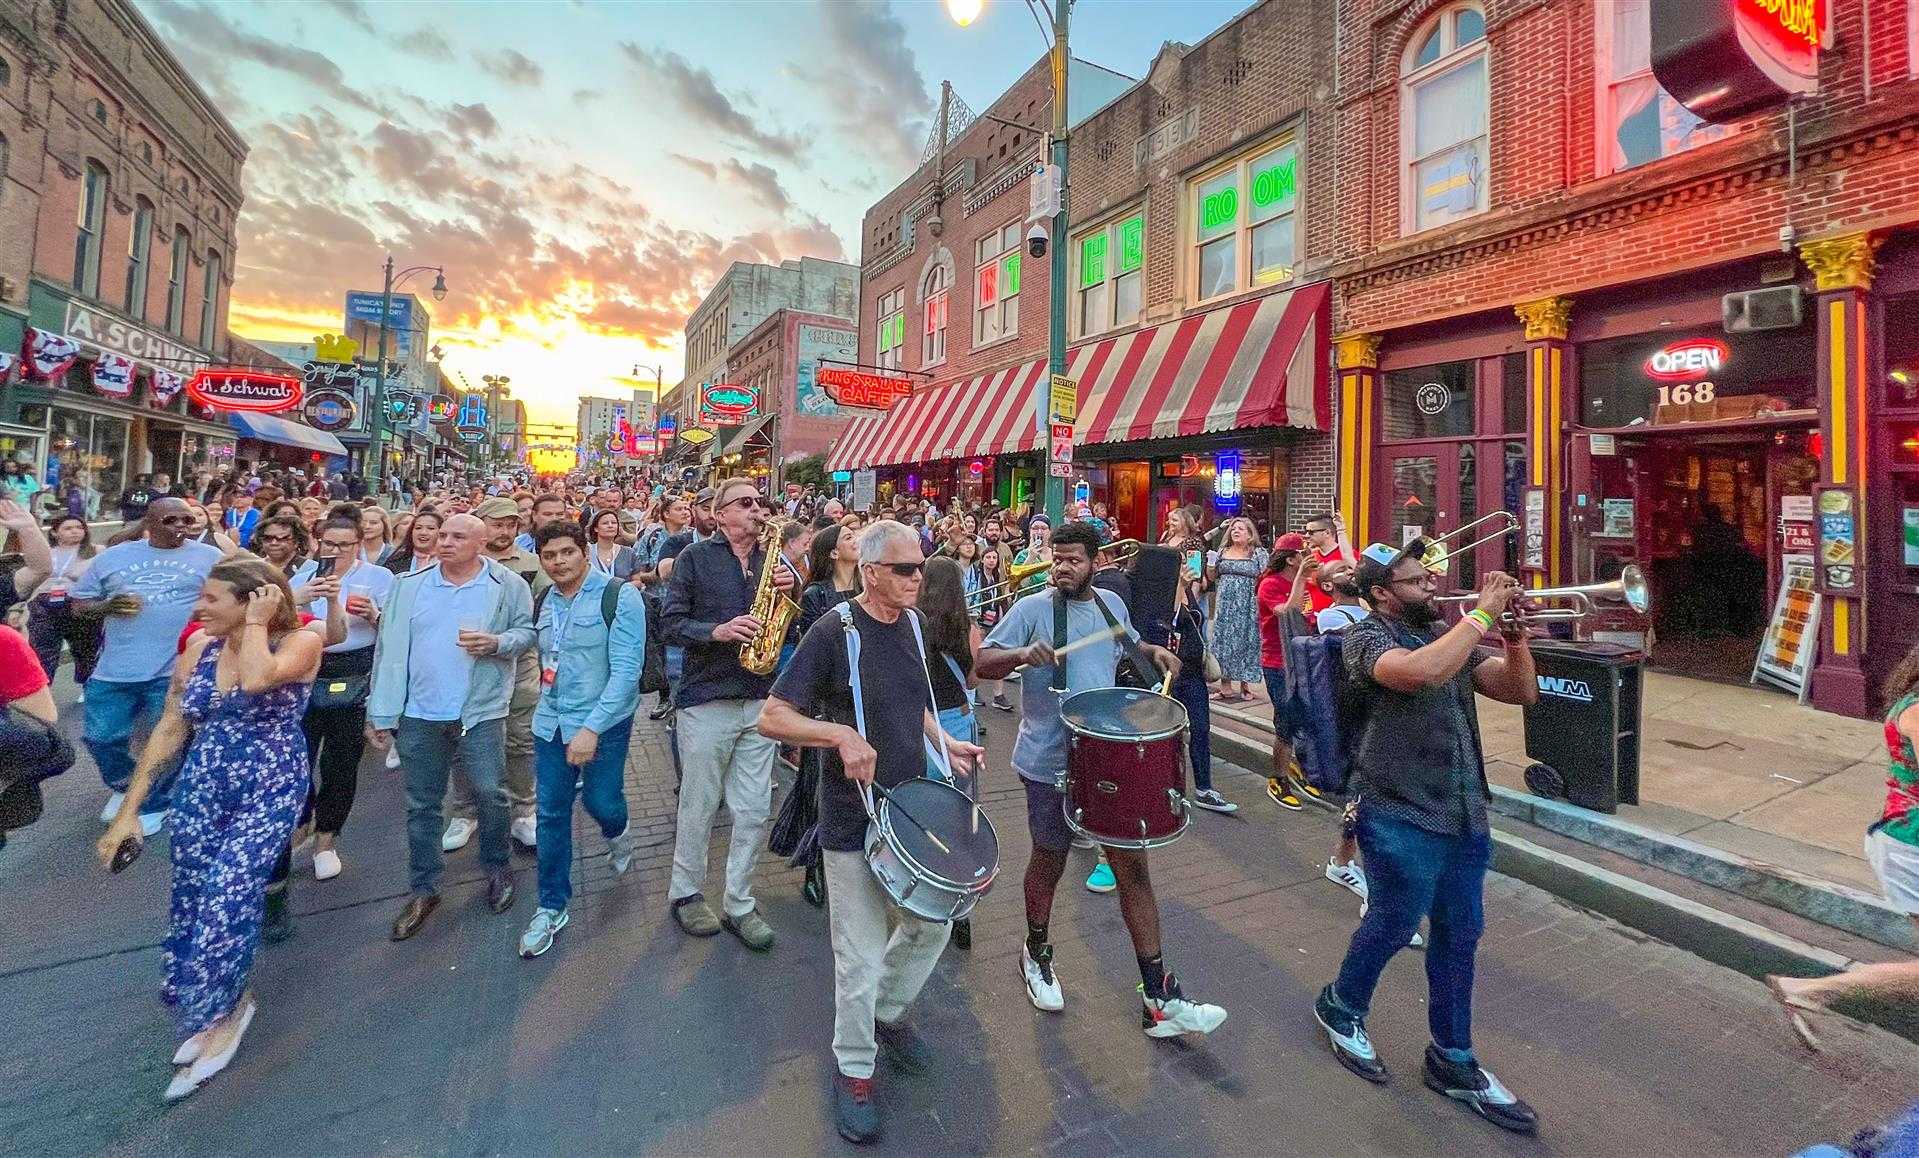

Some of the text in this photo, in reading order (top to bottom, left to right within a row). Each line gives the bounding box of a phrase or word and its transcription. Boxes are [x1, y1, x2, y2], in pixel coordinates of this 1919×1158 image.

[1652, 347, 1720, 371] OPEN
[195, 375, 296, 397] A. Schwab
[841, 387, 891, 406] CAFE
[1656, 381, 1715, 406] 168
[1055, 427, 1069, 437] NO
[1787, 527, 1799, 536] 21
[1536, 675, 1593, 698] WM
